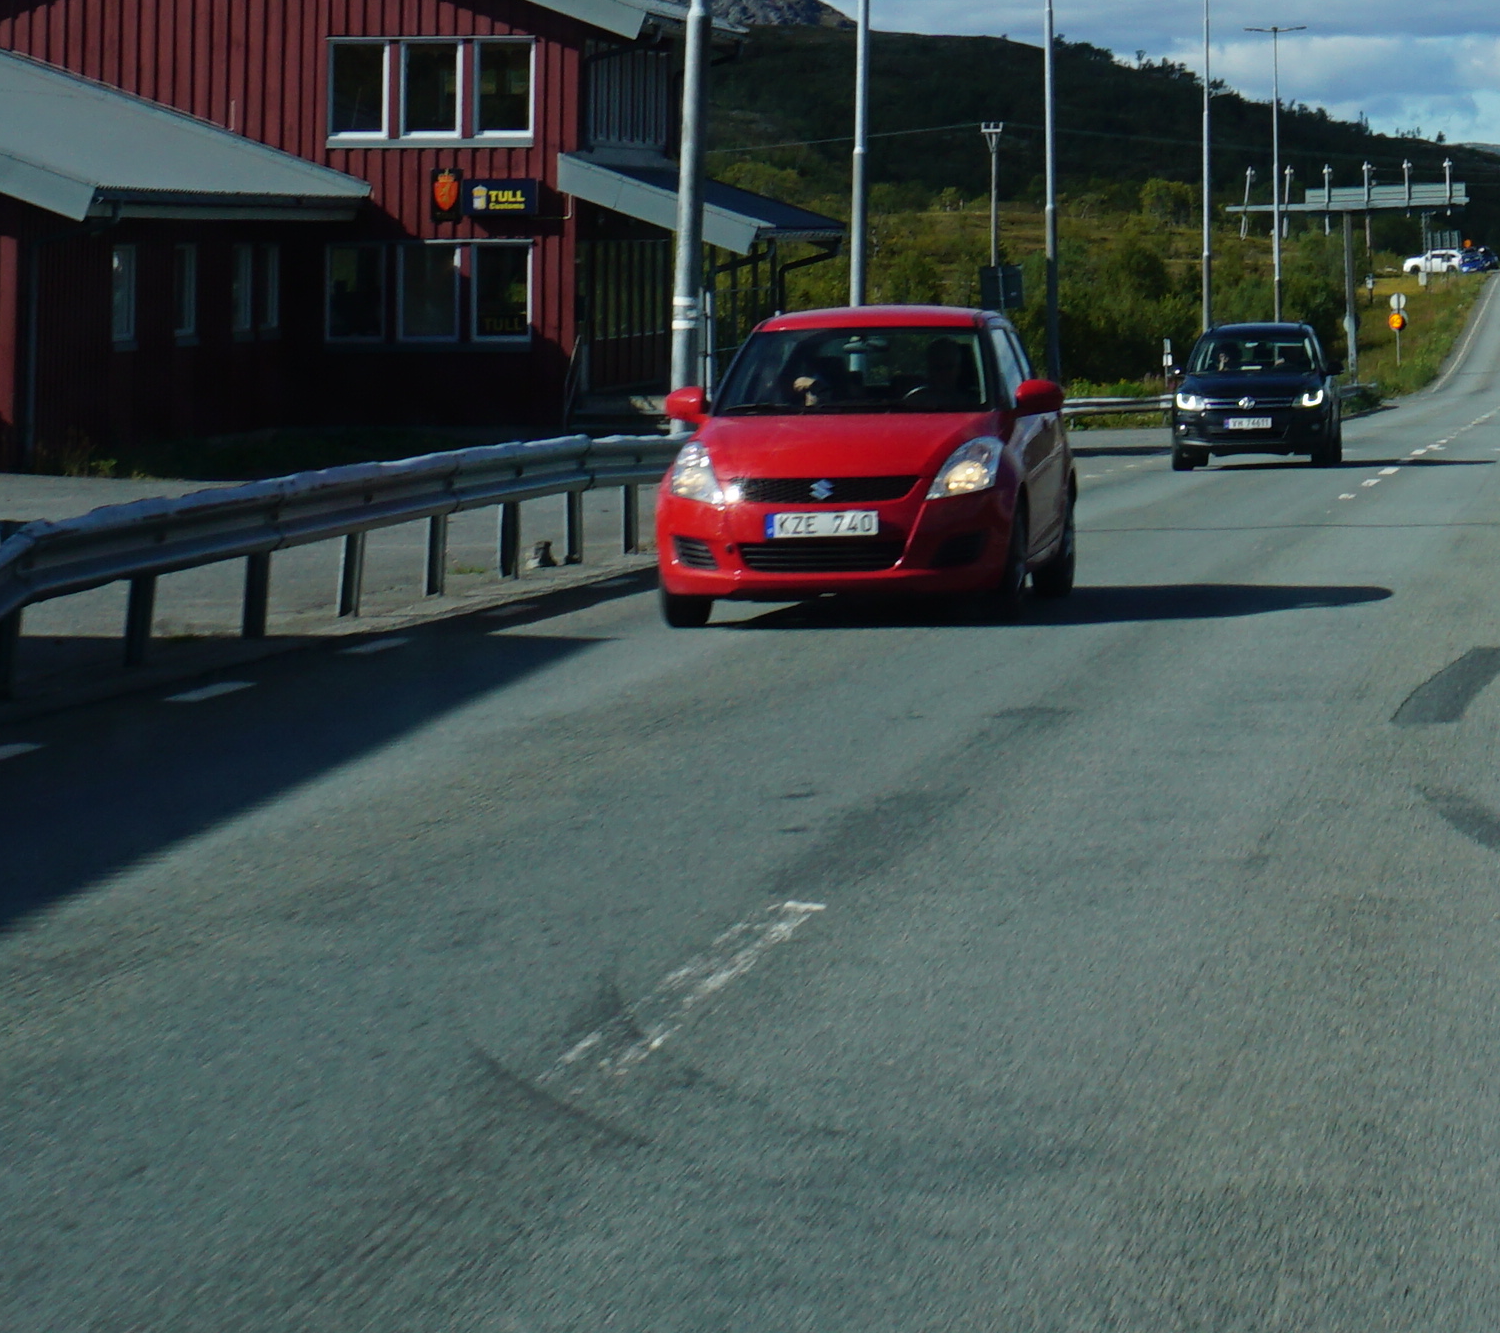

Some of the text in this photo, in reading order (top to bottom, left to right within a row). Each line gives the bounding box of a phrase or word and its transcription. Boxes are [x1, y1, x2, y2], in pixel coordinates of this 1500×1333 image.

[488, 190, 525, 202] TULL
[778, 513, 874, 535] KZE 740
